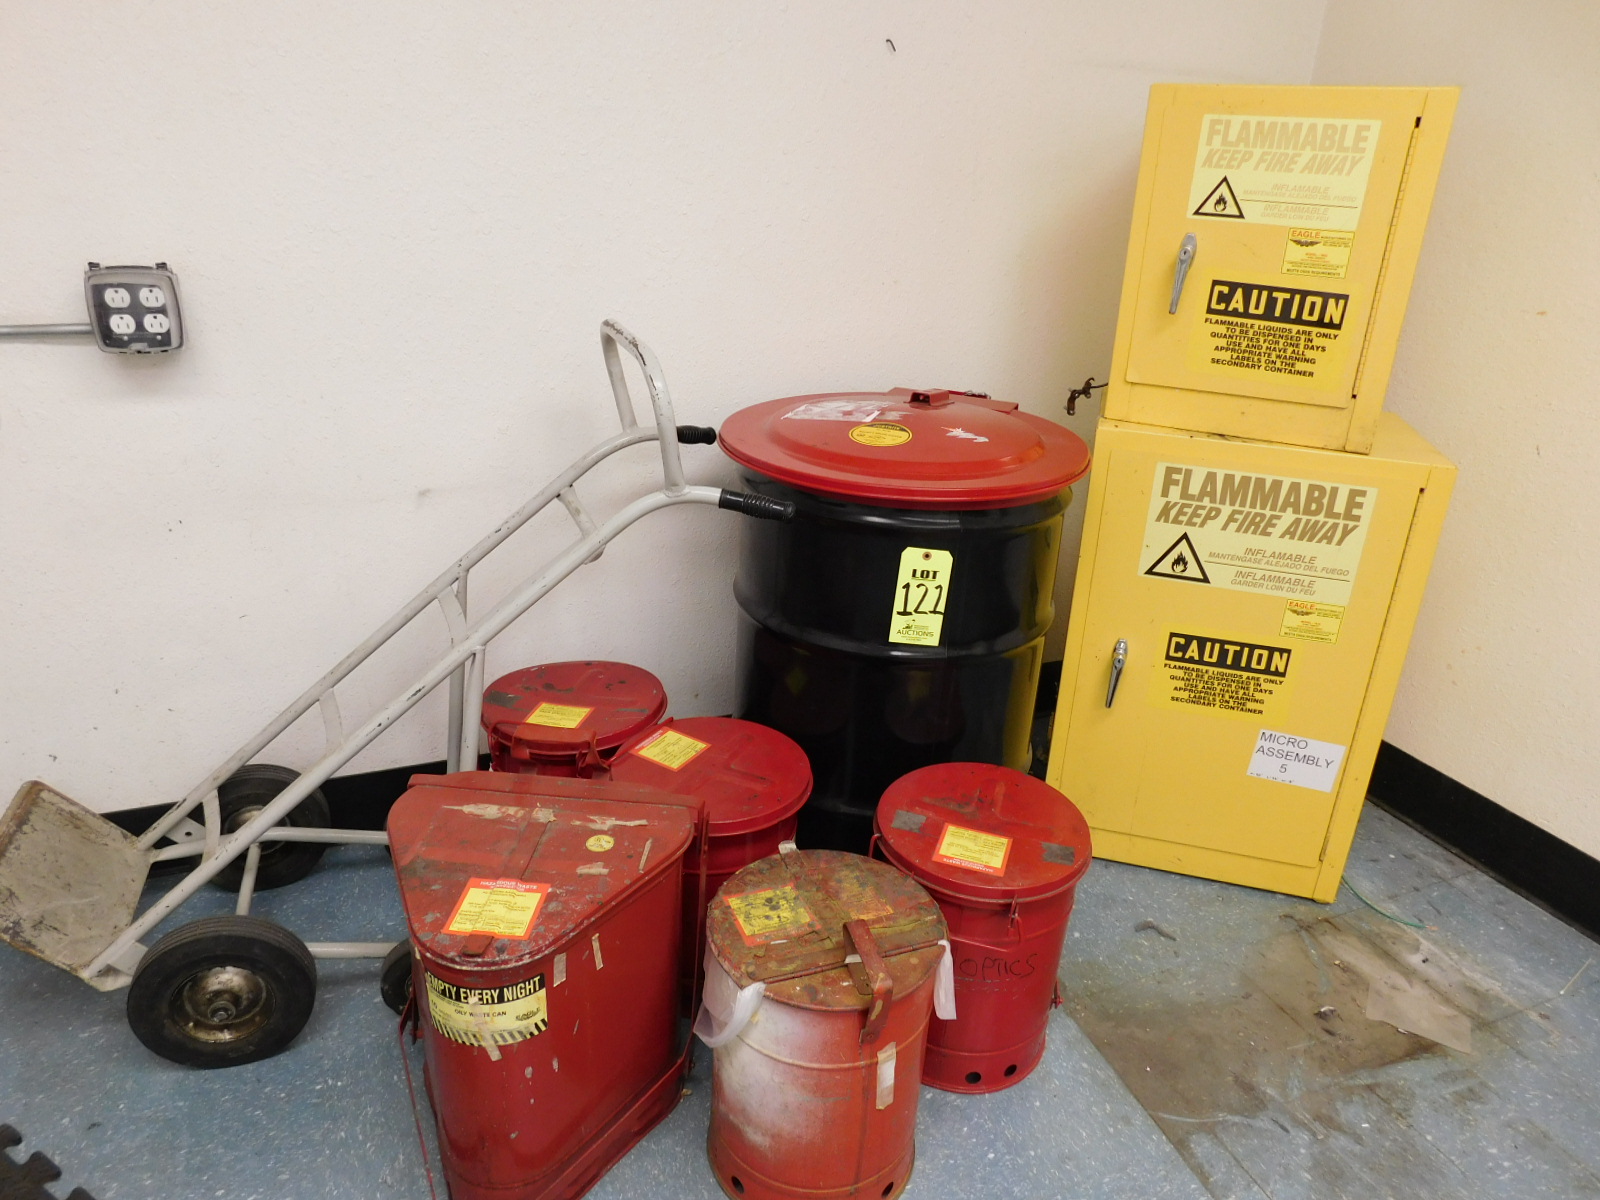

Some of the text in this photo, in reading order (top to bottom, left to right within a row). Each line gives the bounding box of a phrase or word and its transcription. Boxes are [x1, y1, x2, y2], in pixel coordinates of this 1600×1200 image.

[1206, 119, 1371, 154] FLAMMABLE
[1201, 148, 1365, 177] KEEP FIRE AWAY
[1272, 184, 1331, 194] INFLAMABLE
[1263, 205, 1329, 215] INFLAMMABLE
[1291, 230, 1320, 239] EAGLE
[1210, 285, 1345, 324] CAUTION
[1204, 318, 1339, 341] FLAMMABLE LIQUIDS ARE ONLY
[1252, 330, 1305, 343] DISPENSED
[1210, 332, 1327, 352] QUANTITIES FOR ONE DAYS
[1226, 340, 1241, 348] USE
[1245, 343, 1263, 351] AND
[1266, 346, 1287, 354] HAVE
[1214, 346, 1316, 365] APPROPRIATE WARNING
[1230, 354, 1262, 364] LABELS
[1280, 361, 1296, 369] THE
[1211, 357, 1314, 378] SECONDARY CONTAINER
[1160, 466, 1367, 522] FLAMMABLE
[1155, 500, 1360, 546] KEEP FIRE AWAY
[1208, 552, 1349, 576] MANTENGASE ALEJADO DEL FUEGO
[1244, 548, 1317, 564] INFLAMABLE
[912, 569, 940, 579] LOT
[1234, 570, 1316, 588] INFLAMMABLE
[1231, 579, 1316, 596] GARDER LOIN DU FEU
[896, 582, 944, 616] 121
[1289, 601, 1315, 609] EAGLE
[896, 629, 934, 637] AUCTIONS
[1168, 636, 1289, 673] CAUTION
[1164, 663, 1209, 674] FLAMMABLE
[1212, 670, 1243, 680] LIQUIDS
[1263, 678, 1284, 686] ONLY
[1207, 674, 1251, 686] DISPENSED
[1170, 675, 1215, 686] QUANTITIES
[1253, 687, 1273, 695] DAYS
[1220, 687, 1240, 695] HAVE
[1173, 686, 1264, 705] APPROPRIATE WARNING
[1188, 694, 1216, 702] LABELS
[1170, 697, 1263, 715] SECONDARY CONTAINER
[1260, 731, 1308, 750] MICRO
[1256, 745, 1334, 769] ASSEMBLY
[1279, 763, 1287, 774] 5
[959, 953, 1038, 980] OPTICS
[460, 989, 500, 1004] EVERY
[504, 976, 541, 1002] NIGHT
